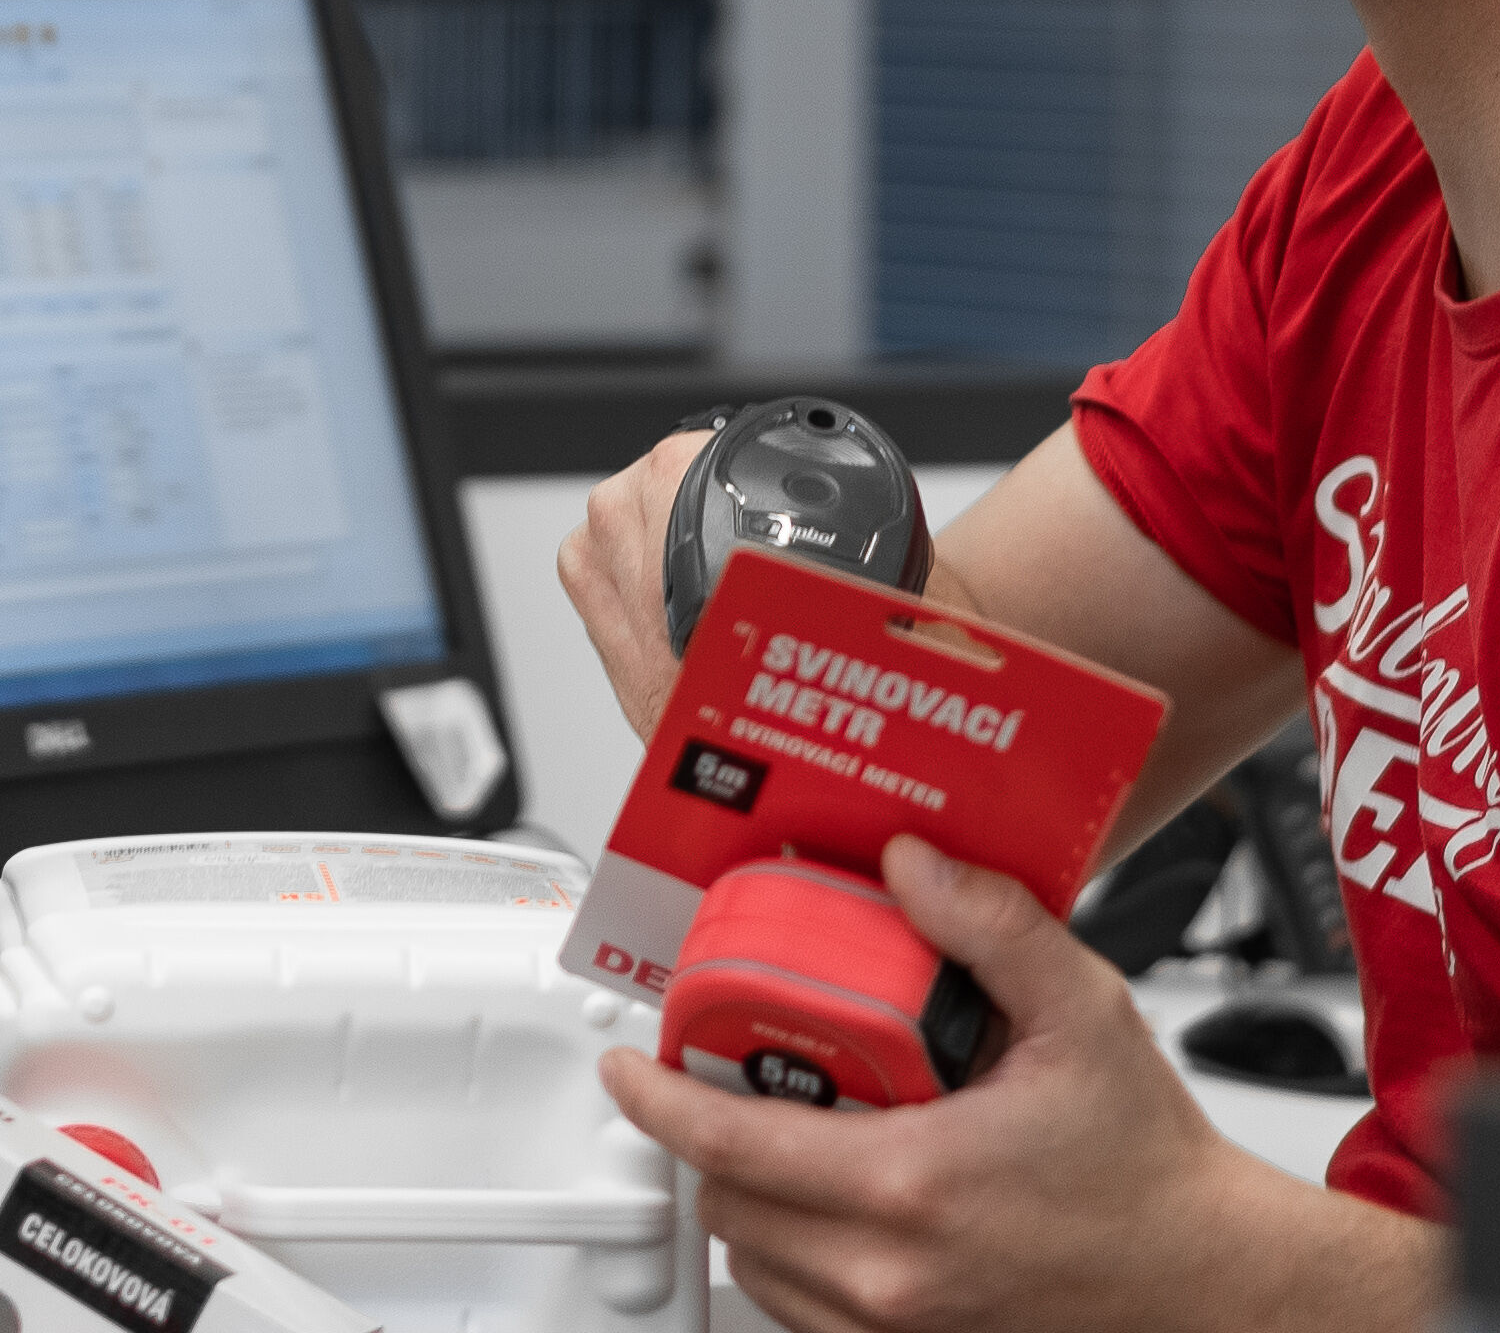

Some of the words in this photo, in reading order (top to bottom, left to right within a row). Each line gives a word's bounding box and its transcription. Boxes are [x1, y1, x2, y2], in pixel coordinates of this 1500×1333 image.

[744, 672, 886, 748] METR
[761, 633, 1026, 752] SVINOVACÍ
[593, 941, 672, 995] DE
[17, 1211, 177, 1326] CELOKOVOVÁ
